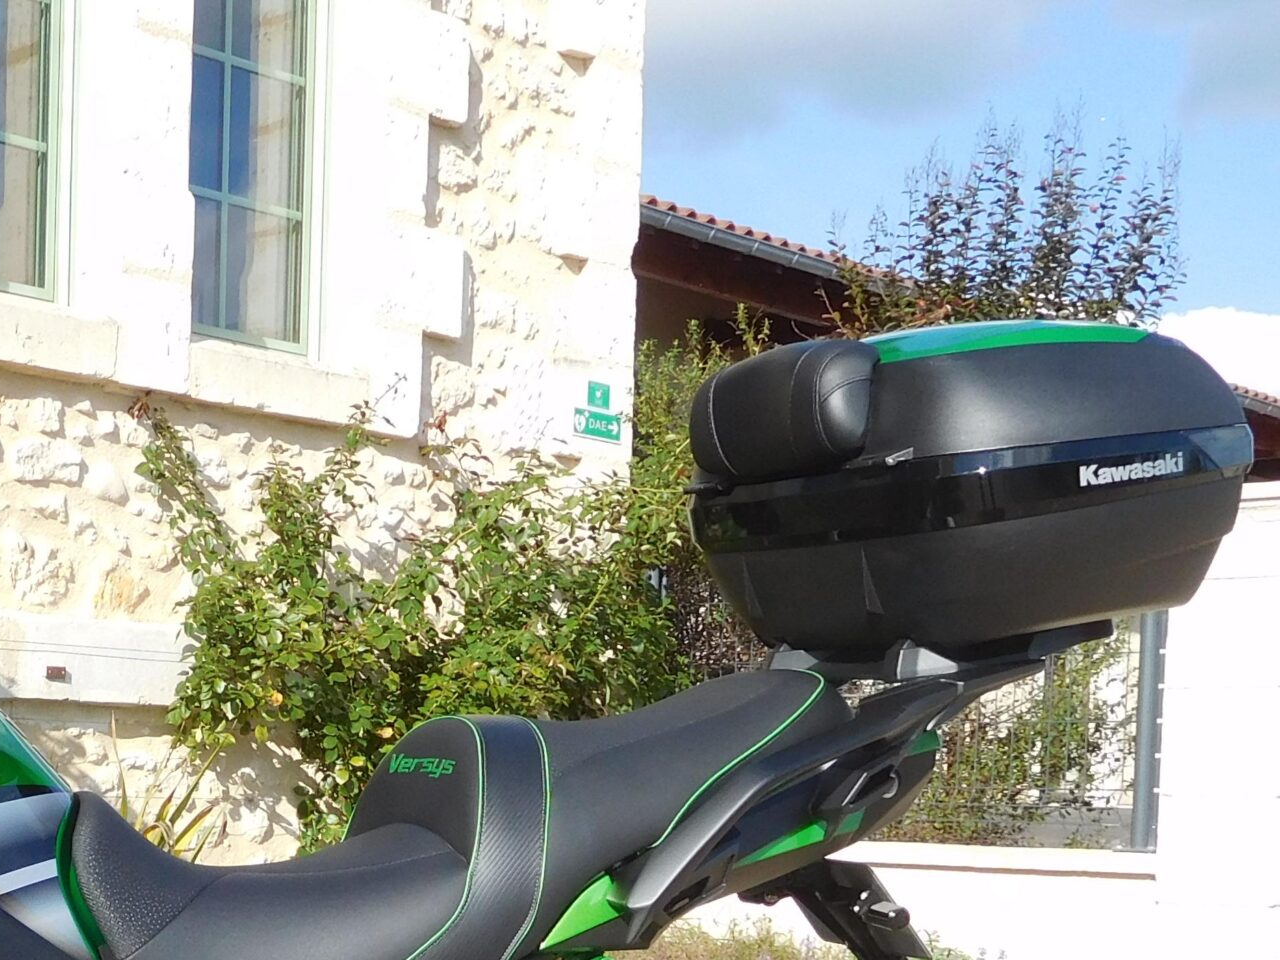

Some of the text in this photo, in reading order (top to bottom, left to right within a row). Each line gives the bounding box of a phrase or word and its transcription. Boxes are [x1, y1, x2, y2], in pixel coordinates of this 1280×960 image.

[589, 418, 607, 432] DAE
[1079, 452, 1184, 487] Kawasaki
[389, 753, 456, 778] Versys
